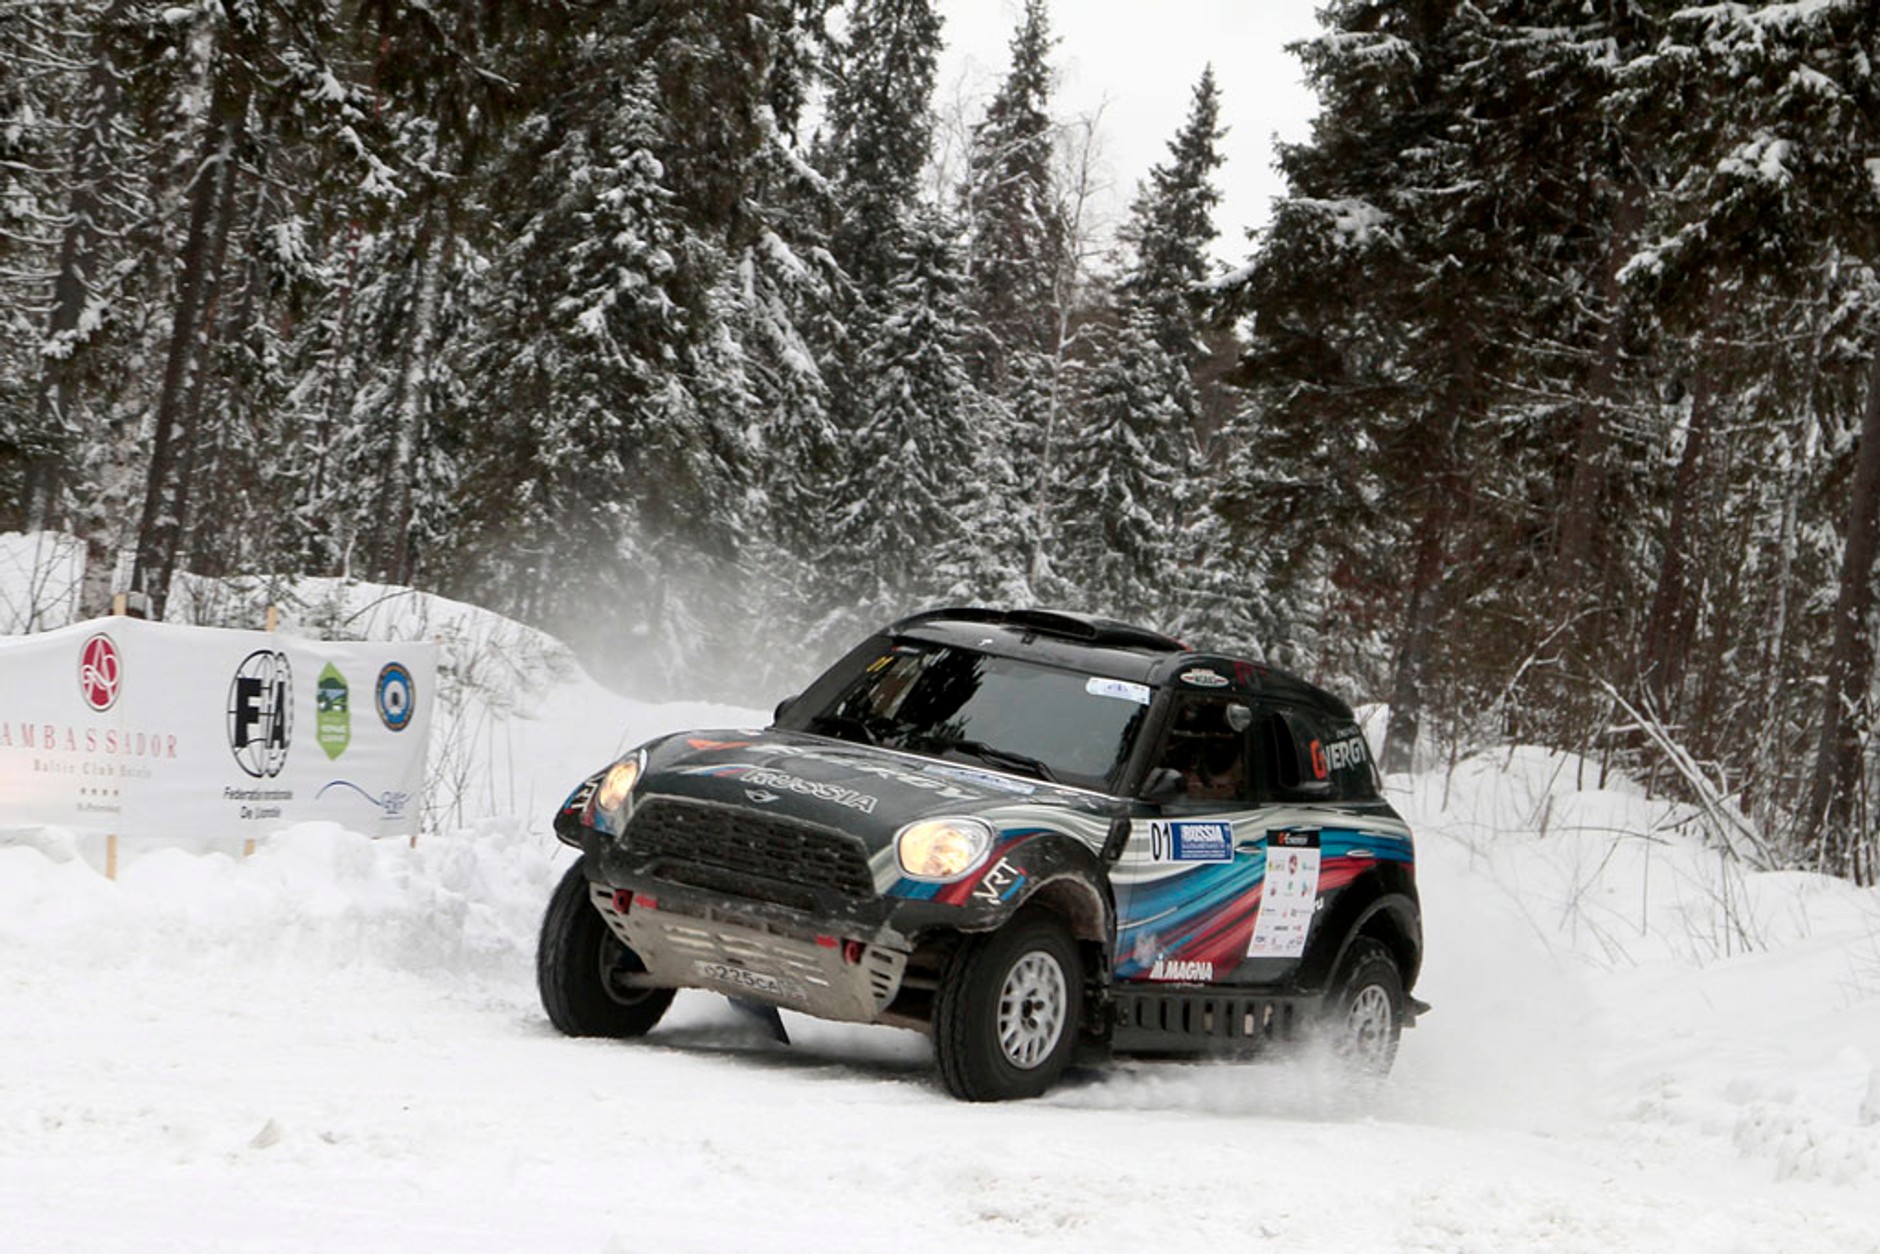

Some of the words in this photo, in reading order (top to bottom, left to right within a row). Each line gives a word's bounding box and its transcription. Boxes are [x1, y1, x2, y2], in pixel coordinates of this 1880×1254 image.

[0, 721, 178, 759] AMBASSADOR
[740, 769, 878, 815] RUSSIA
[1151, 823, 1171, 861] 01
[972, 857, 1019, 897] VRT
[1164, 960, 1213, 980] MAGNA
